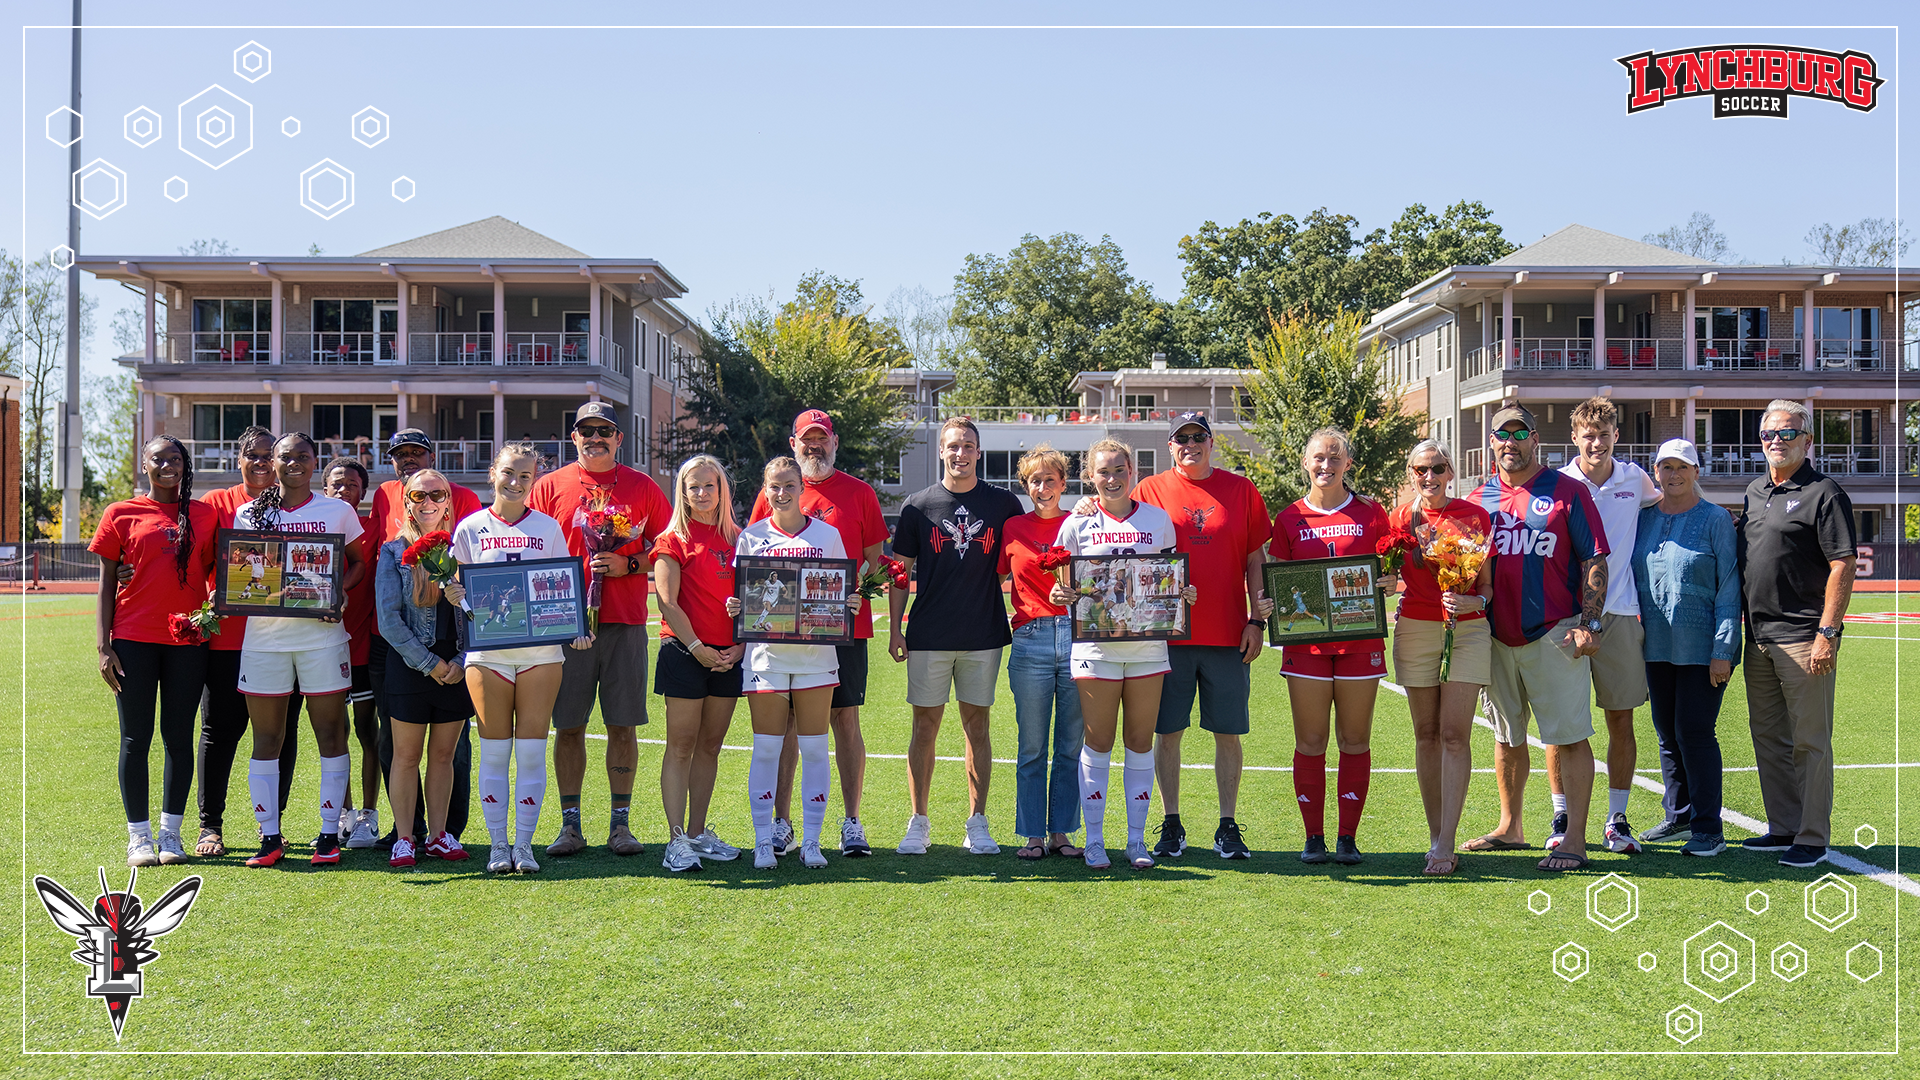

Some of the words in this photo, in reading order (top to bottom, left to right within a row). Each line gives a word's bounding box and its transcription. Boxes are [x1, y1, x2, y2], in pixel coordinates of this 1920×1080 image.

[1092, 532, 1153, 545] LYNCHBURG
[1299, 524, 1363, 541] LYNCHBURG
[480, 536, 544, 551] LYNCHBURG
[1495, 529, 1557, 558] awa
